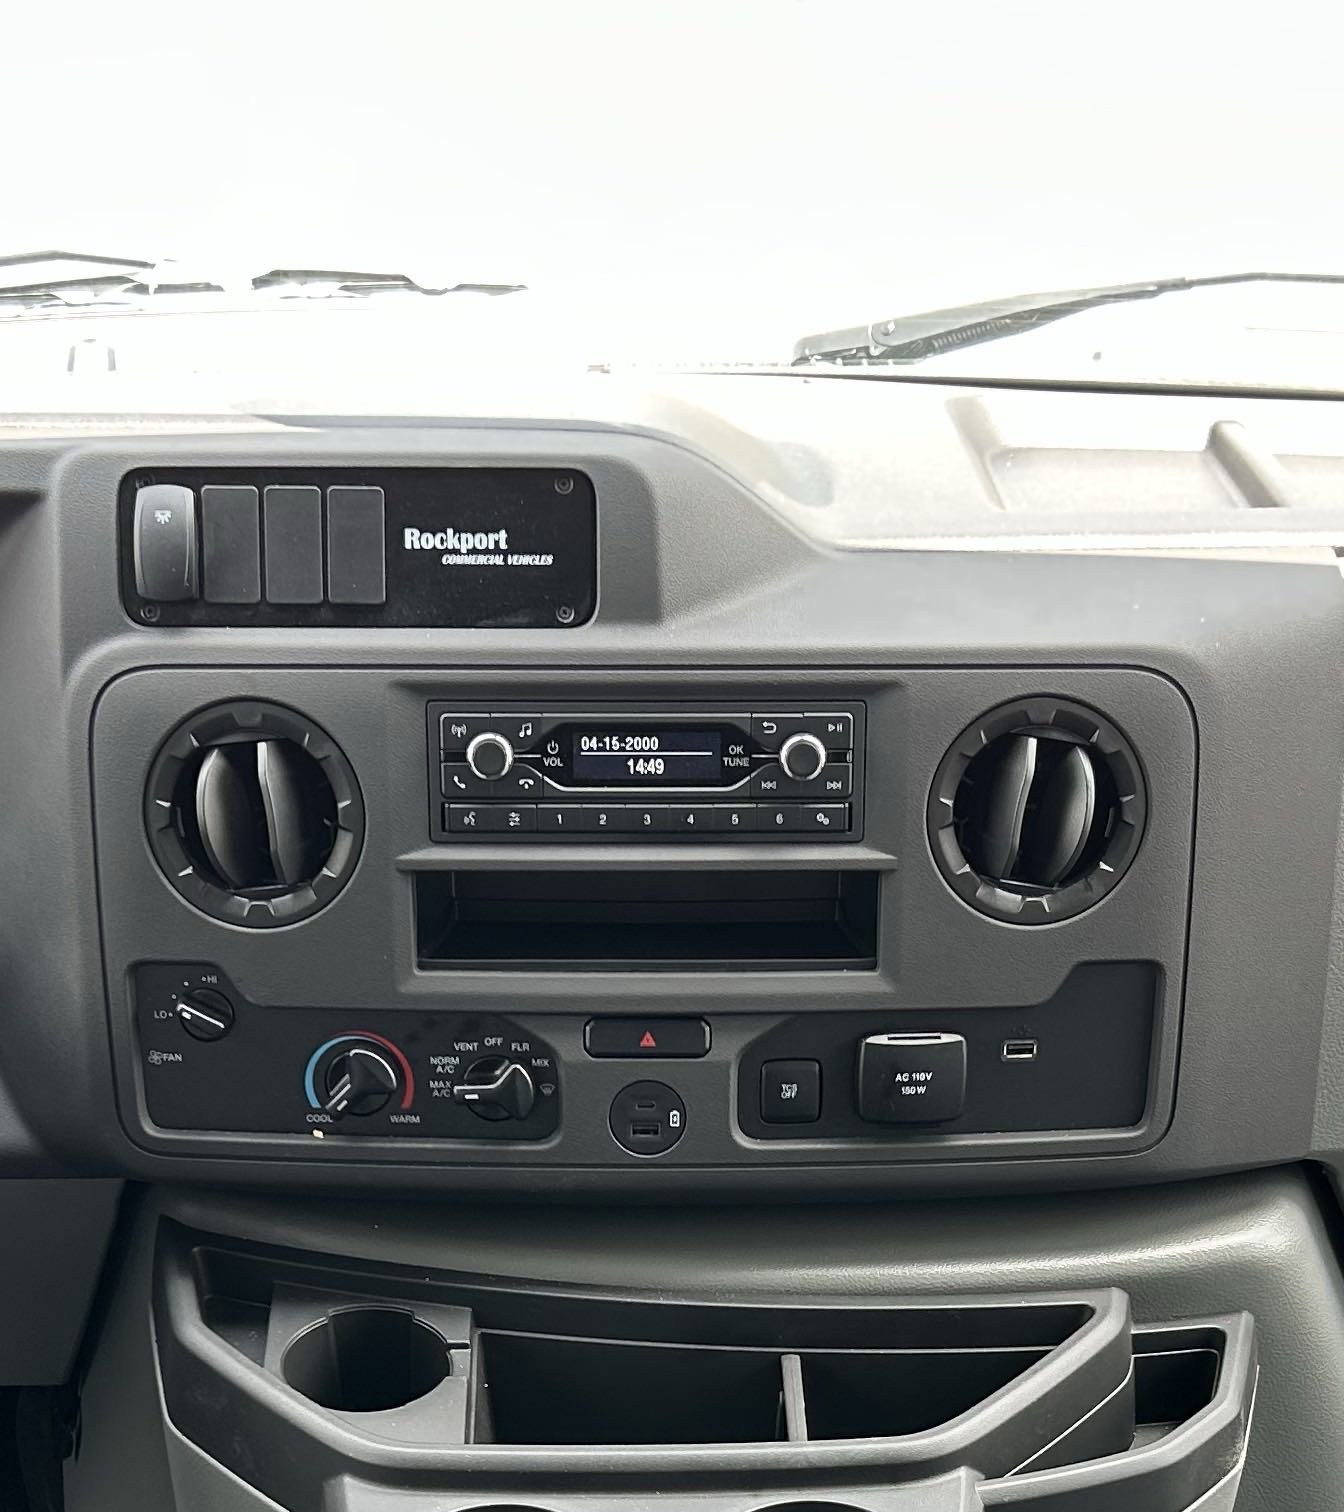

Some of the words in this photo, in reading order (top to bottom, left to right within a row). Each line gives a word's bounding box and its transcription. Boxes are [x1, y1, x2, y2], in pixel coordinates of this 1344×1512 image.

[404, 527, 508, 553] Rockport
[441, 554, 505, 565] COMMERCIAL
[507, 554, 554, 565] VEHICLES
[580, 736, 659, 750] 04-15-2000
[728, 745, 744, 755] OK
[543, 757, 563, 767] VOL
[626, 758, 665, 775] 14:49
[723, 757, 750, 767] TUNE
[557, 814, 562, 825] 1
[599, 814, 607, 825] 2
[643, 814, 651, 825] 3
[687, 814, 694, 825] 4
[731, 814, 739, 825] 5
[776, 813, 784, 825] 6
[207, 975, 218, 984] HI
[154, 1010, 167, 1019] LO
[454, 1042, 479, 1052] VENT
[484, 1037, 503, 1047] OFF
[511, 1042, 530, 1052] FLR
[162, 1053, 183, 1062] FAN
[429, 1056, 460, 1065] NORM
[531, 1058, 549, 1067] MIX
[436, 1065, 455, 1074] A/C
[895, 1073, 909, 1082] AC
[429, 1080, 452, 1089] MAX
[432, 1089, 451, 1098] A/C
[306, 1114, 334, 1123] COOL
[390, 1114, 421, 1124] WARM
